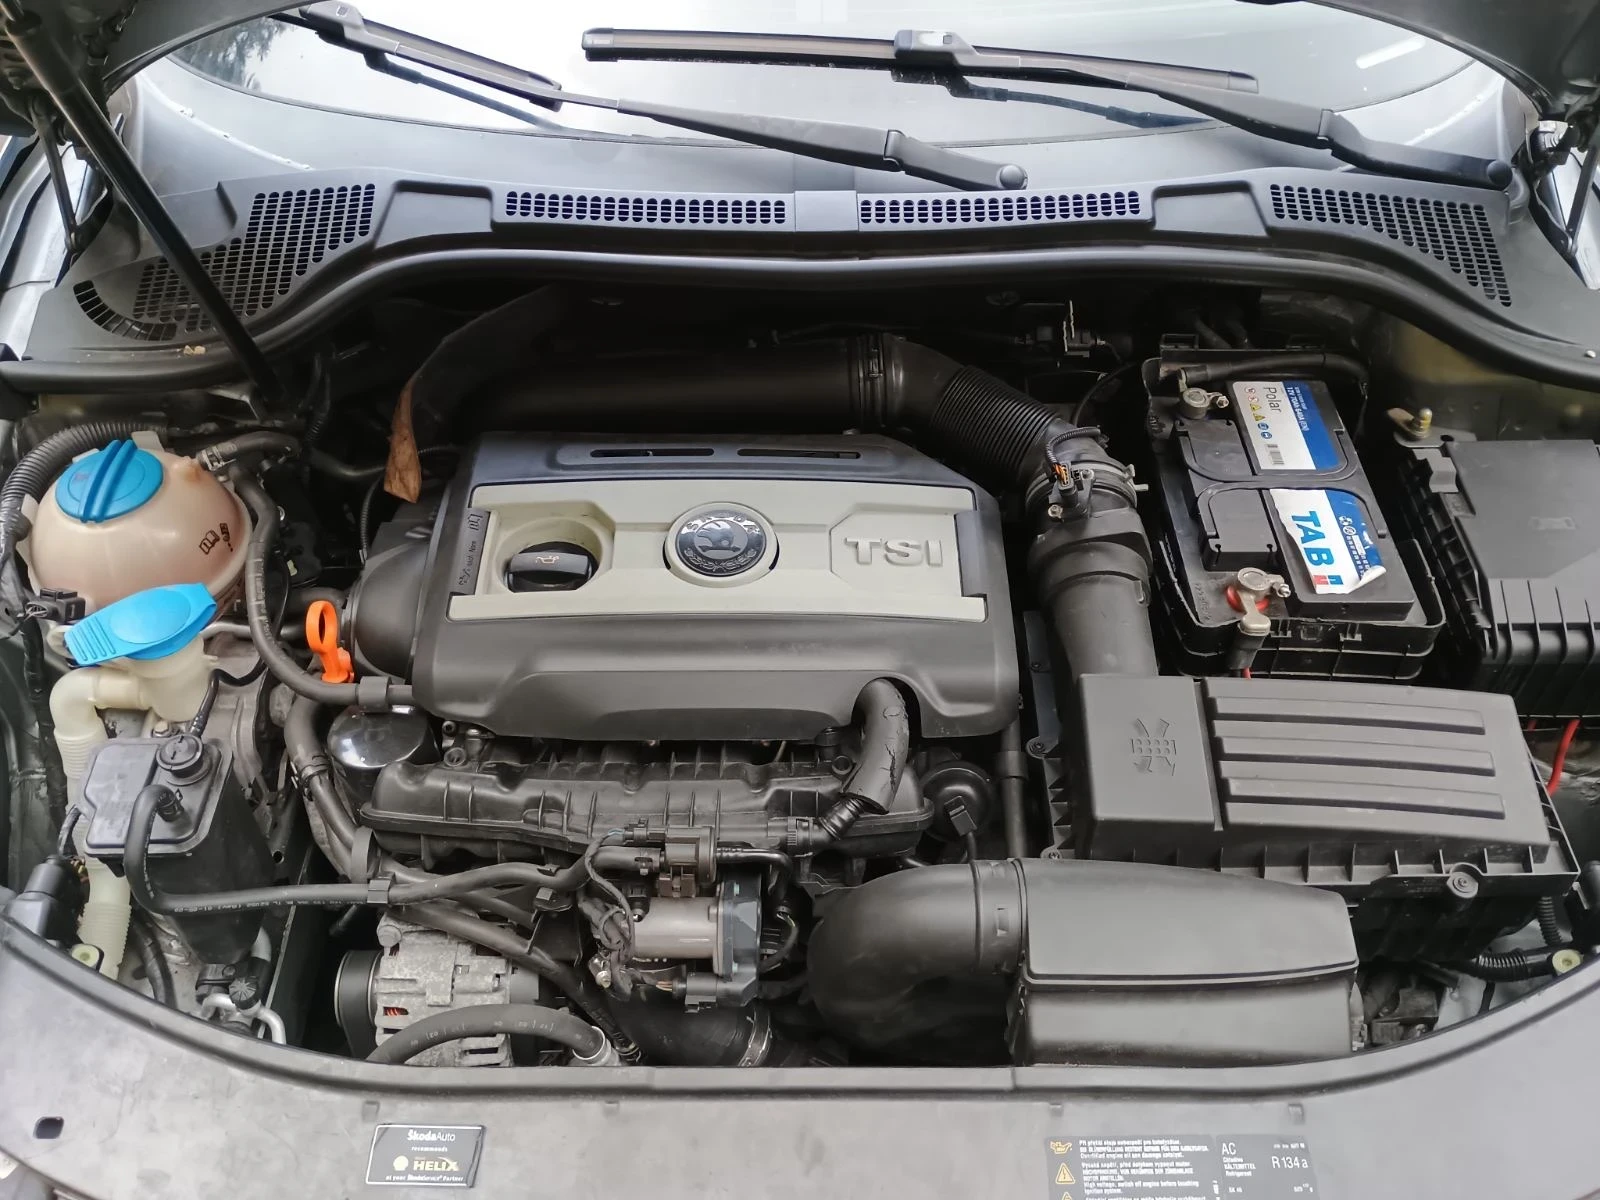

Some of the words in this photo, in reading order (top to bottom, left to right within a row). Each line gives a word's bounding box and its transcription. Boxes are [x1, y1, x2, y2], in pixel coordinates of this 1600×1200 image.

[1263, 387, 1282, 412] Polar
[1291, 510, 1335, 567] TAB
[844, 536, 944, 567] TSI
[1222, 1142, 1236, 1155] AC
[413, 1157, 460, 1171] HELIX
